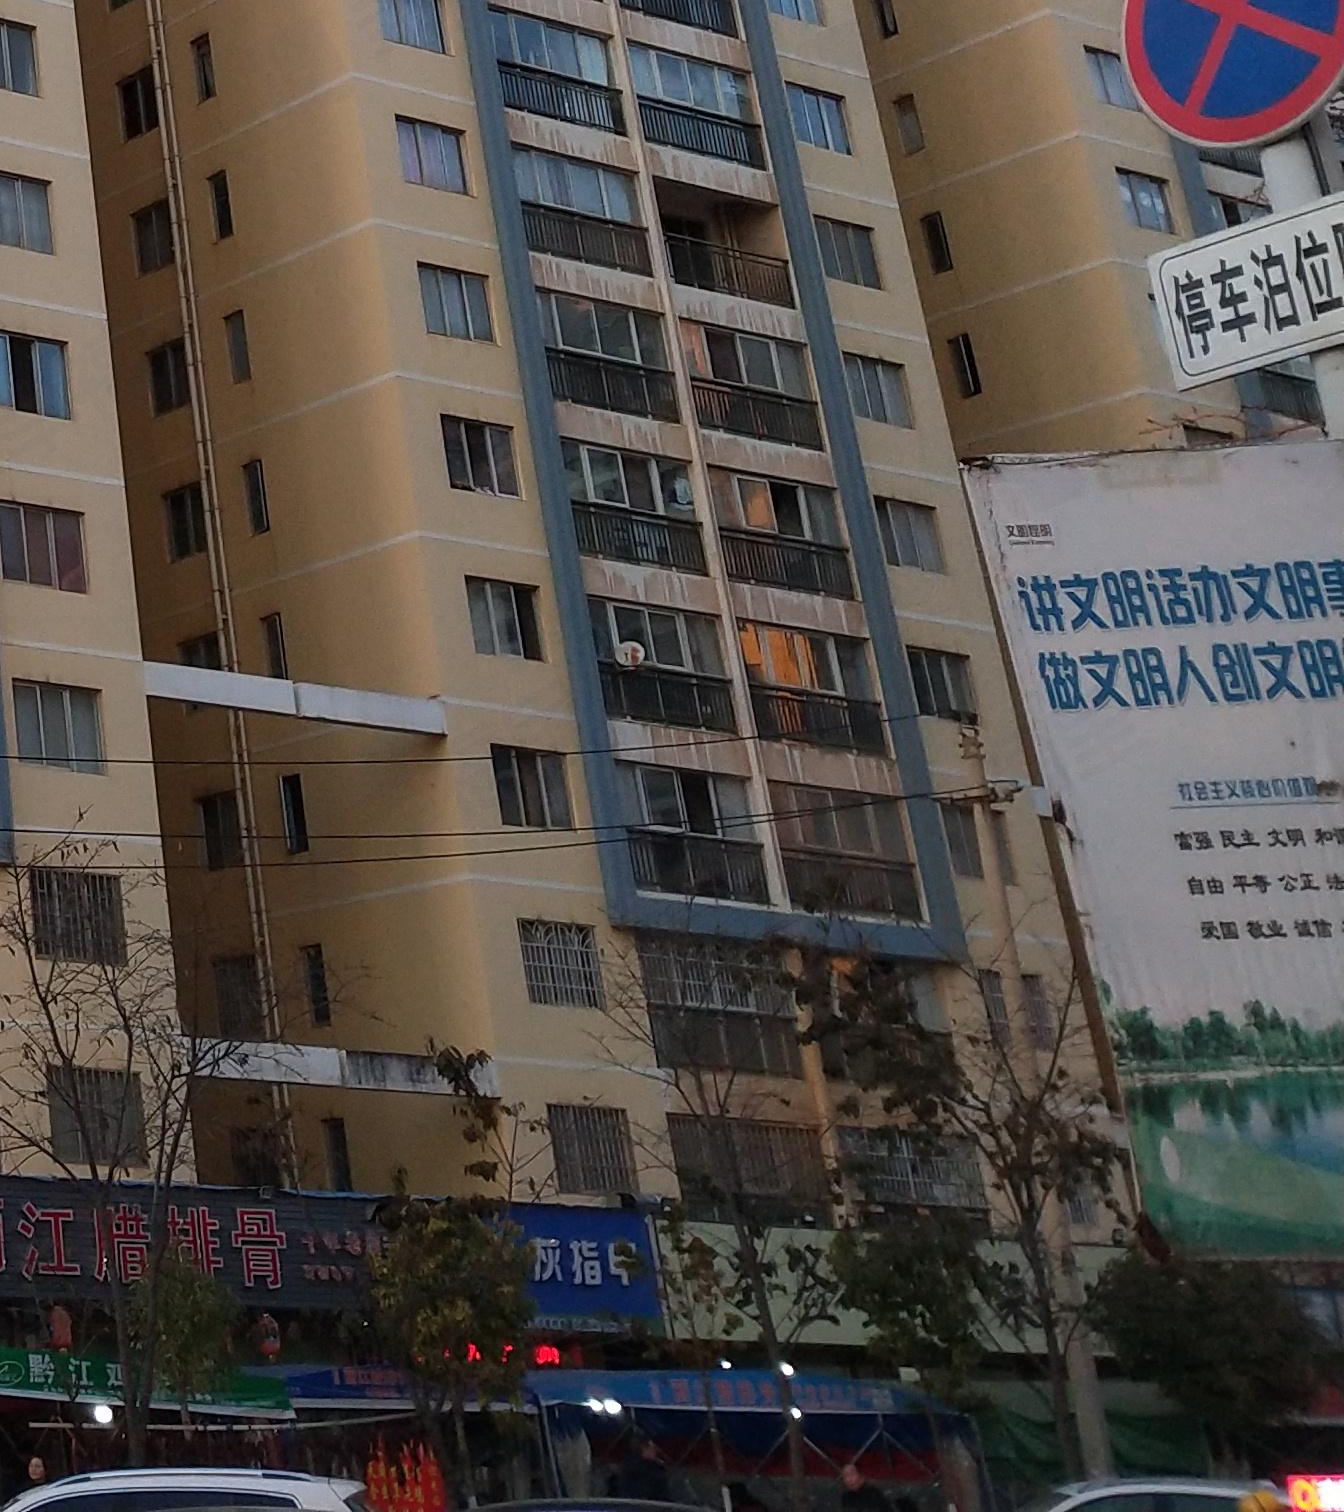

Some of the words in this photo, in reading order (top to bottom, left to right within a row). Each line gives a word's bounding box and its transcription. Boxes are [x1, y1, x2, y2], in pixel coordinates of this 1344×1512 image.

[1173, 223, 1344, 360] 停车泊位
[1174, 831, 1214, 850] 富强
[1219, 829, 1260, 848] 民主
[1268, 828, 1306, 847] 文明
[1187, 876, 1224, 896] 自由
